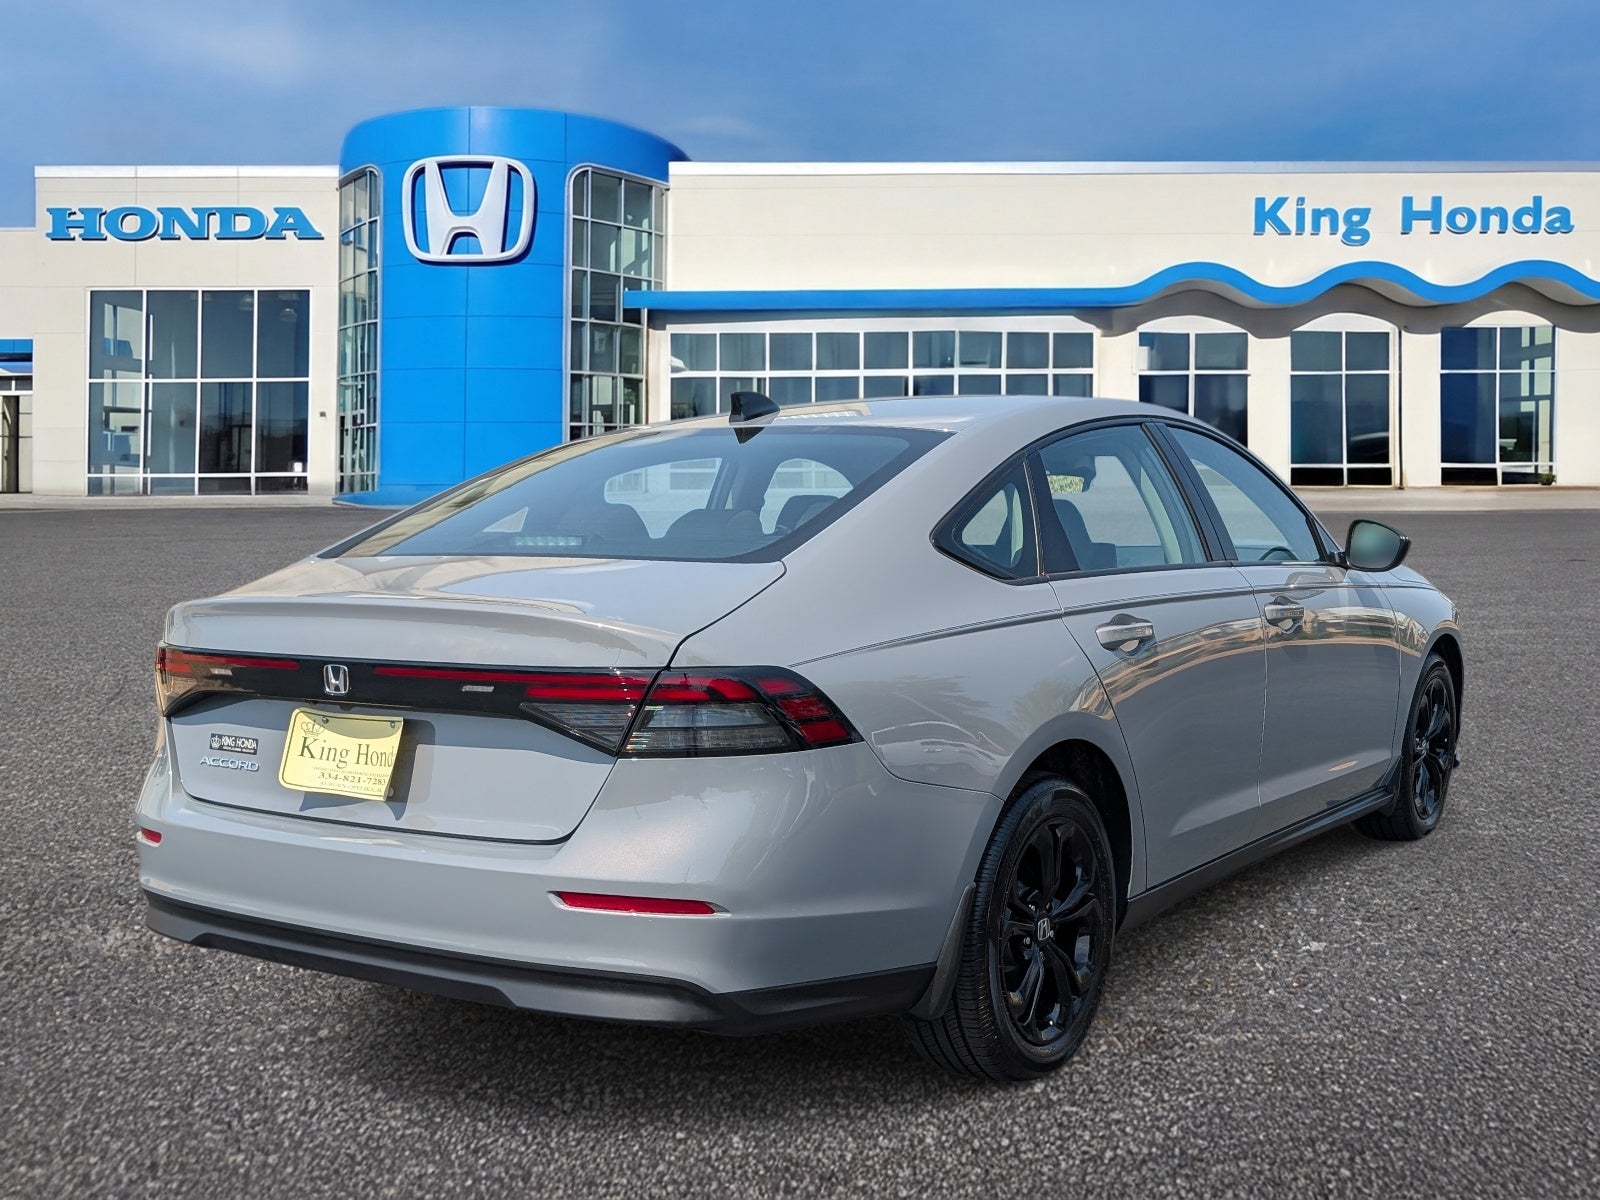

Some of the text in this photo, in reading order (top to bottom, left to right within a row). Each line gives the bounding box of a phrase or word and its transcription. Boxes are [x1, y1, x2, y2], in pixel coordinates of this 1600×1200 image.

[46, 206, 325, 241] HONDA
[1253, 195, 1575, 246] King Honda
[221, 735, 235, 747] KING
[236, 737, 257, 750] HONDA
[298, 736, 397, 769] King Hond
[200, 756, 260, 772] ACCORD
[318, 771, 386, 787] 334-821-7283
